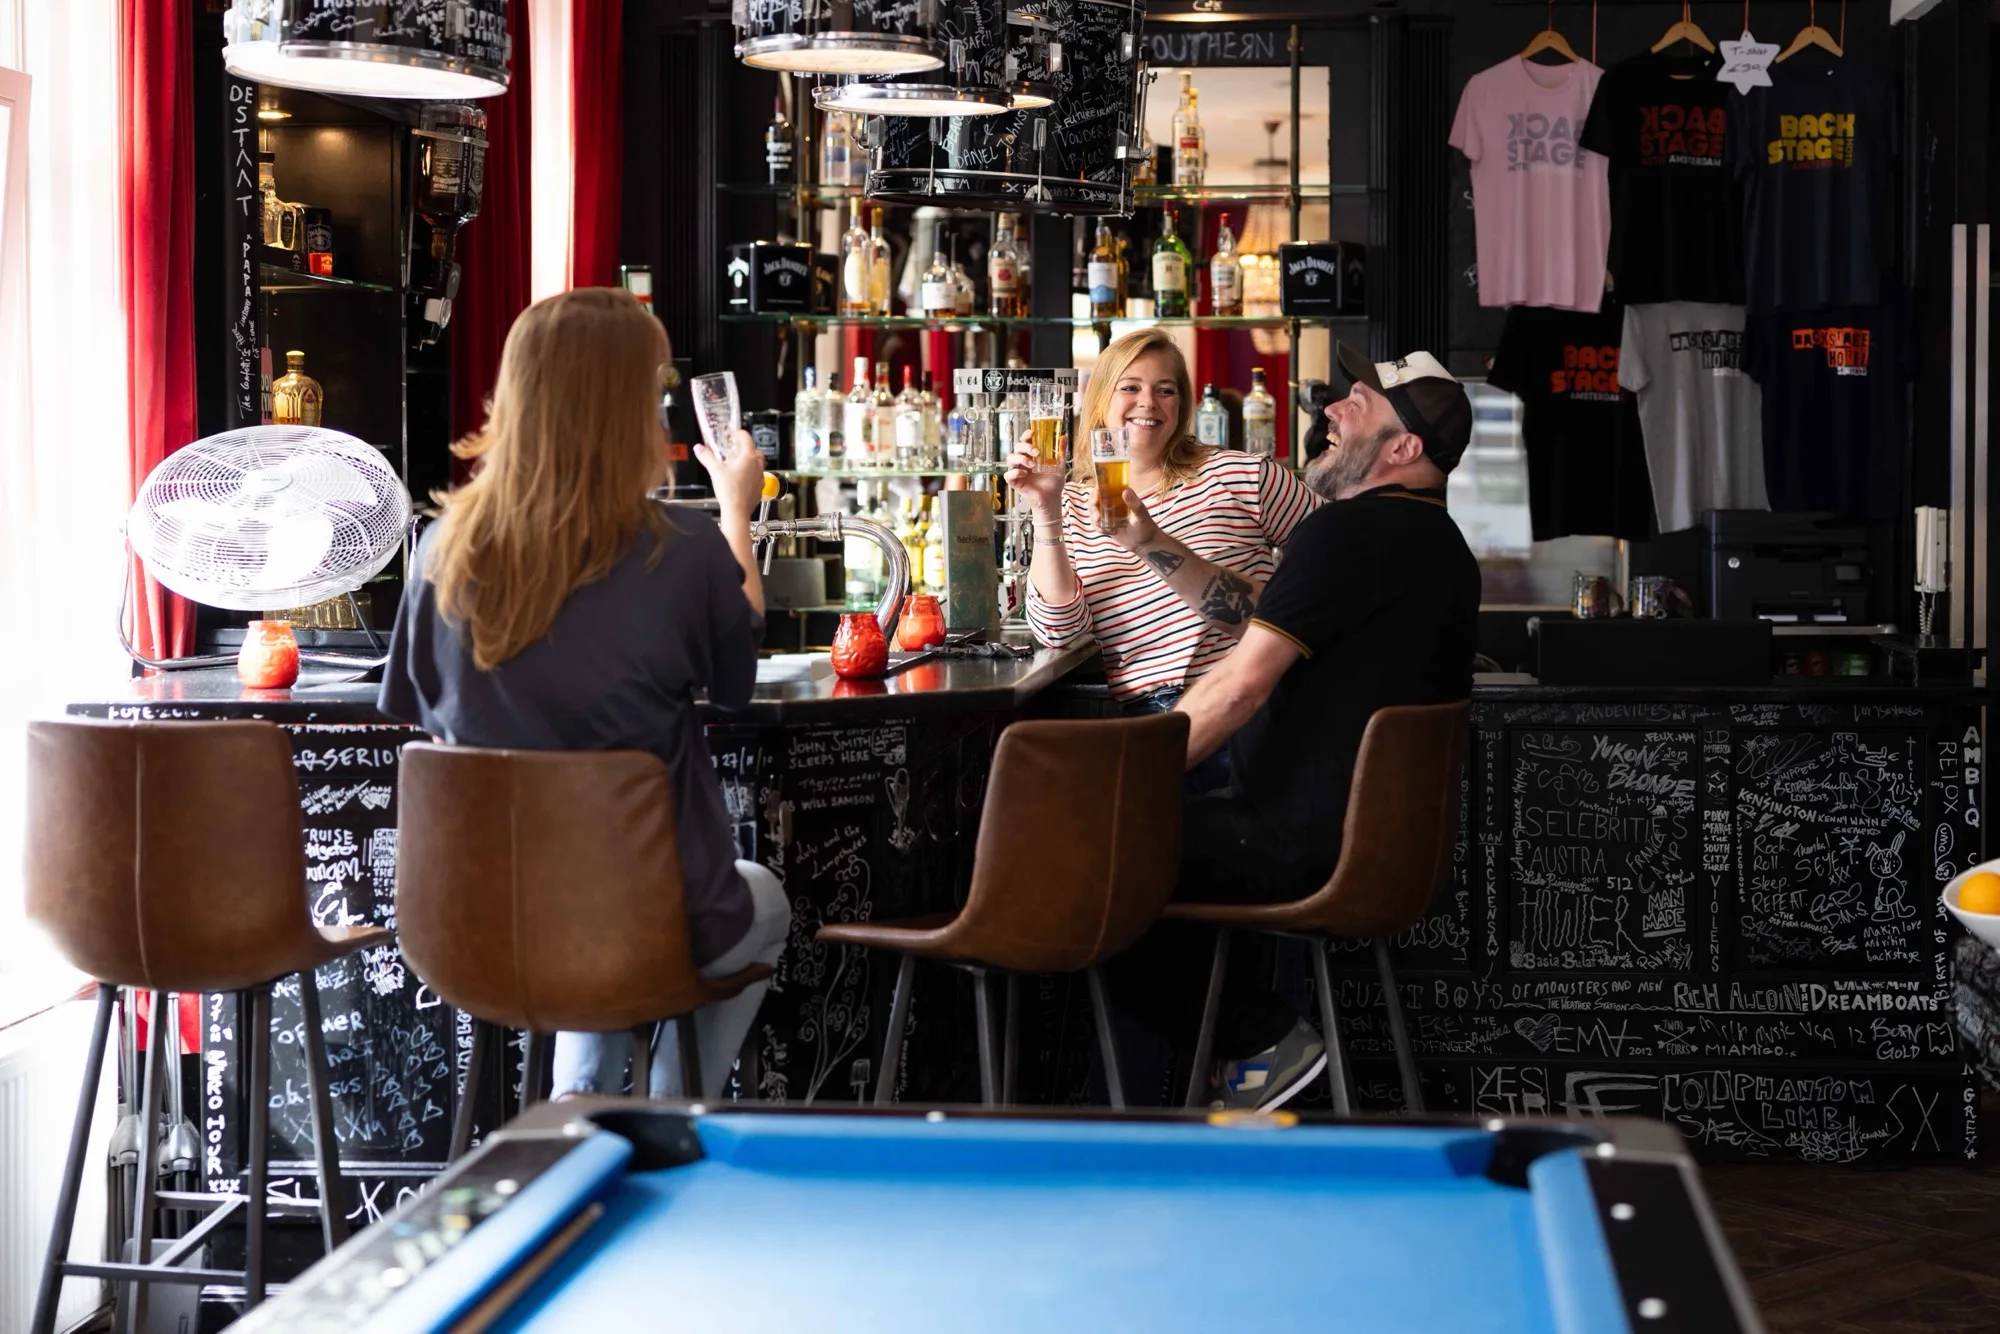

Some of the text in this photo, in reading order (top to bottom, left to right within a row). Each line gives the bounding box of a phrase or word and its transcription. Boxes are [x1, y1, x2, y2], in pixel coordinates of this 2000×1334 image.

[1640, 131, 1724, 160] STAGE
[1767, 137, 1845, 166] STAGE
[1669, 154, 1722, 167] AMSTERDAM
[788, 730, 872, 757] JOHN SMITH
[788, 750, 870, 769] SLEEPS HERE
[1606, 763, 1697, 799] BLONDE
[1739, 786, 1817, 823] KENSINGTON
[1525, 807, 1688, 843] SELEBRITIES
[1702, 853, 1729, 865] CITY
[1703, 842, 1731, 854] SOUTH
[1529, 845, 1608, 875] AUSTRA
[1702, 863, 1731, 872] THREE
[1606, 875, 1634, 891] 512
[1647, 886, 1685, 913] MAN
[1642, 907, 1687, 931] MADE
[1511, 978, 1665, 1001] OF MONSTERS AND MEN
[1810, 982, 1939, 1014] DREAMBOATS
[1560, 996, 1591, 1011] WEATHER
[1471, 1015, 1497, 1027] THE
[1662, 1018, 1684, 1031] TWIN
[1628, 1045, 1654, 1057] 2012
[1664, 1043, 1691, 1056] FORKS
[1734, 1074, 1875, 1105] PHANTOM
[1761, 1102, 1843, 1131] LIMB
